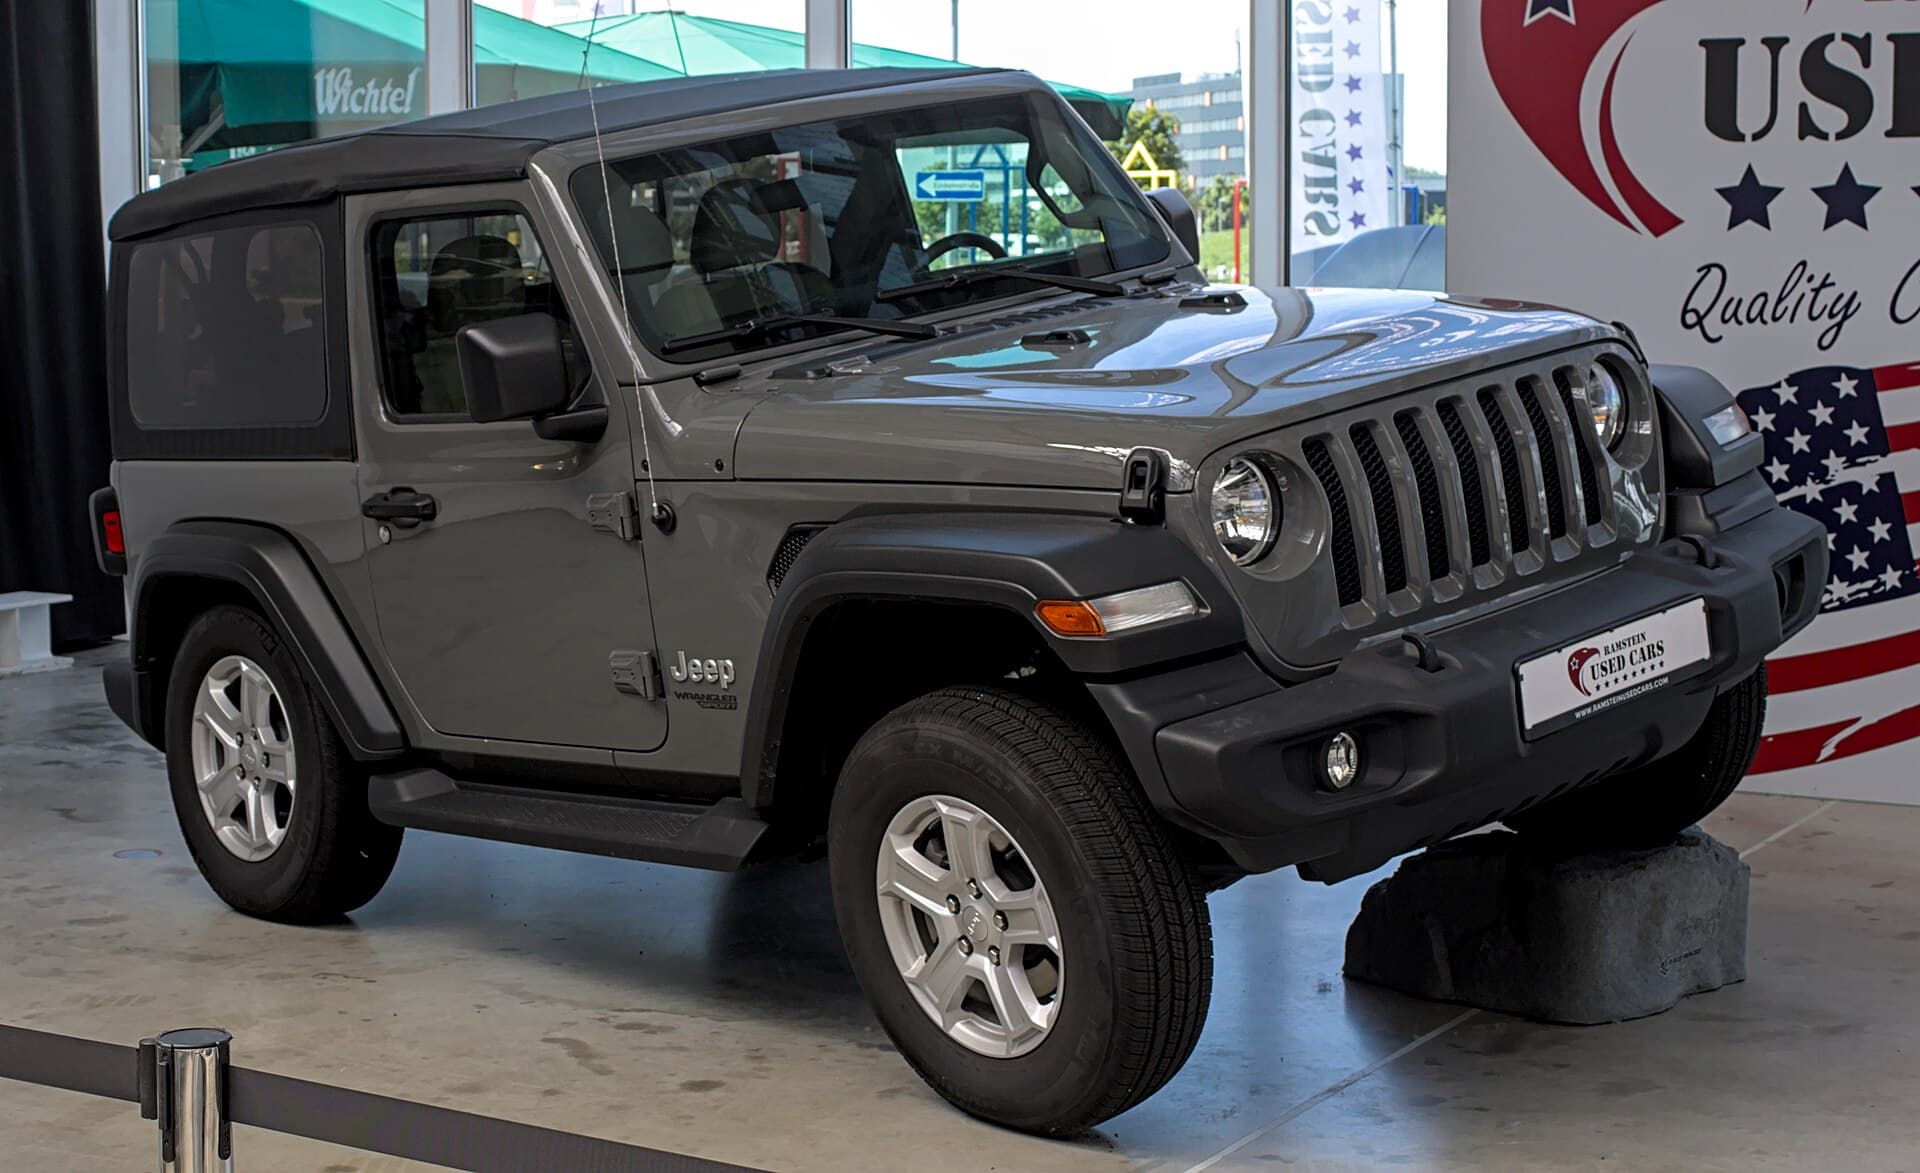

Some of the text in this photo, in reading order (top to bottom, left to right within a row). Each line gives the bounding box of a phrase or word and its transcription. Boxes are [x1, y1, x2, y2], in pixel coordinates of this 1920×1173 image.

[314, 67, 420, 115] Wichtel
[1680, 259, 1861, 351] Quality
[1590, 640, 1664, 680] USED CARS
[1603, 632, 1646, 656] RAMSTEIN
[670, 650, 735, 690] Jeep
